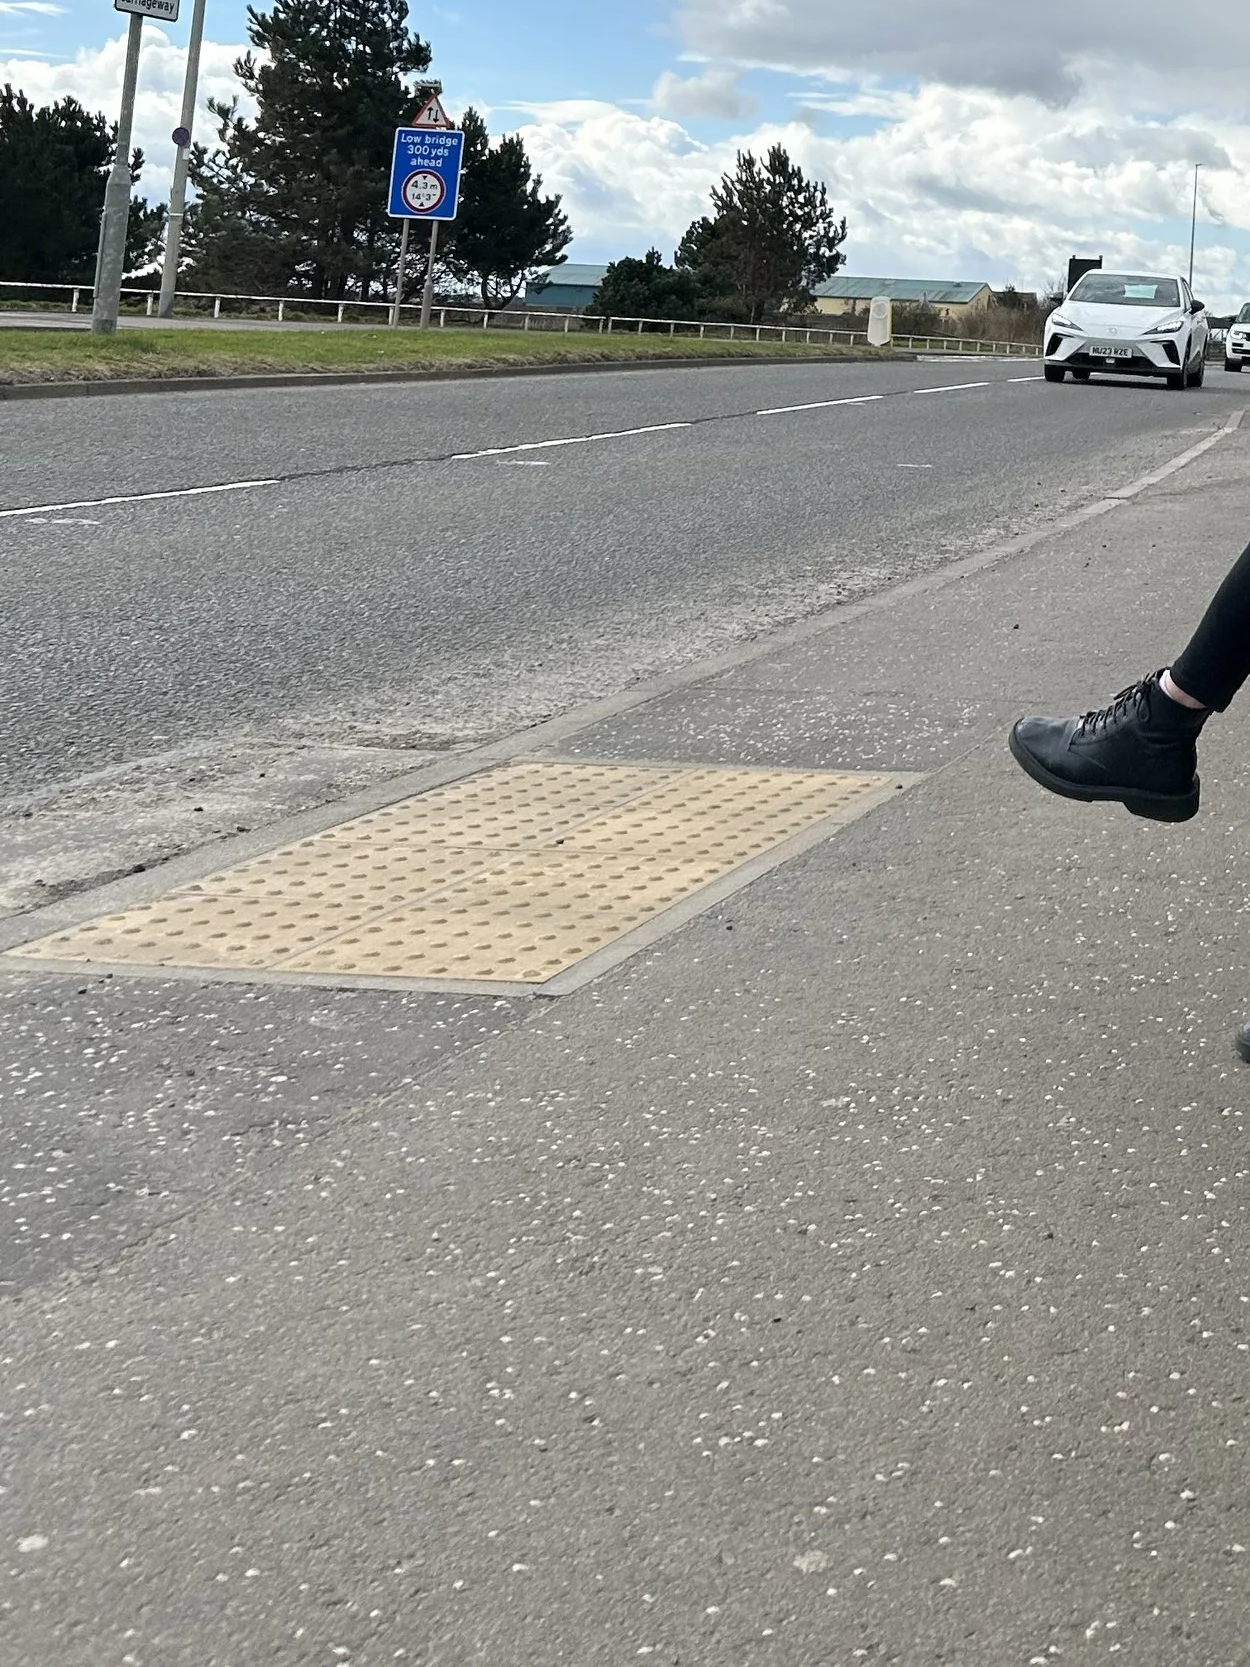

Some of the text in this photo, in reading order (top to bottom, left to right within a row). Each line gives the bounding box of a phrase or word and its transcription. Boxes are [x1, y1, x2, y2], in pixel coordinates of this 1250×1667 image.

[401, 133, 458, 146] Low bridge
[407, 144, 449, 157] 300 yds
[410, 157, 443, 167] ahead
[411, 180, 428, 190] 4.3
